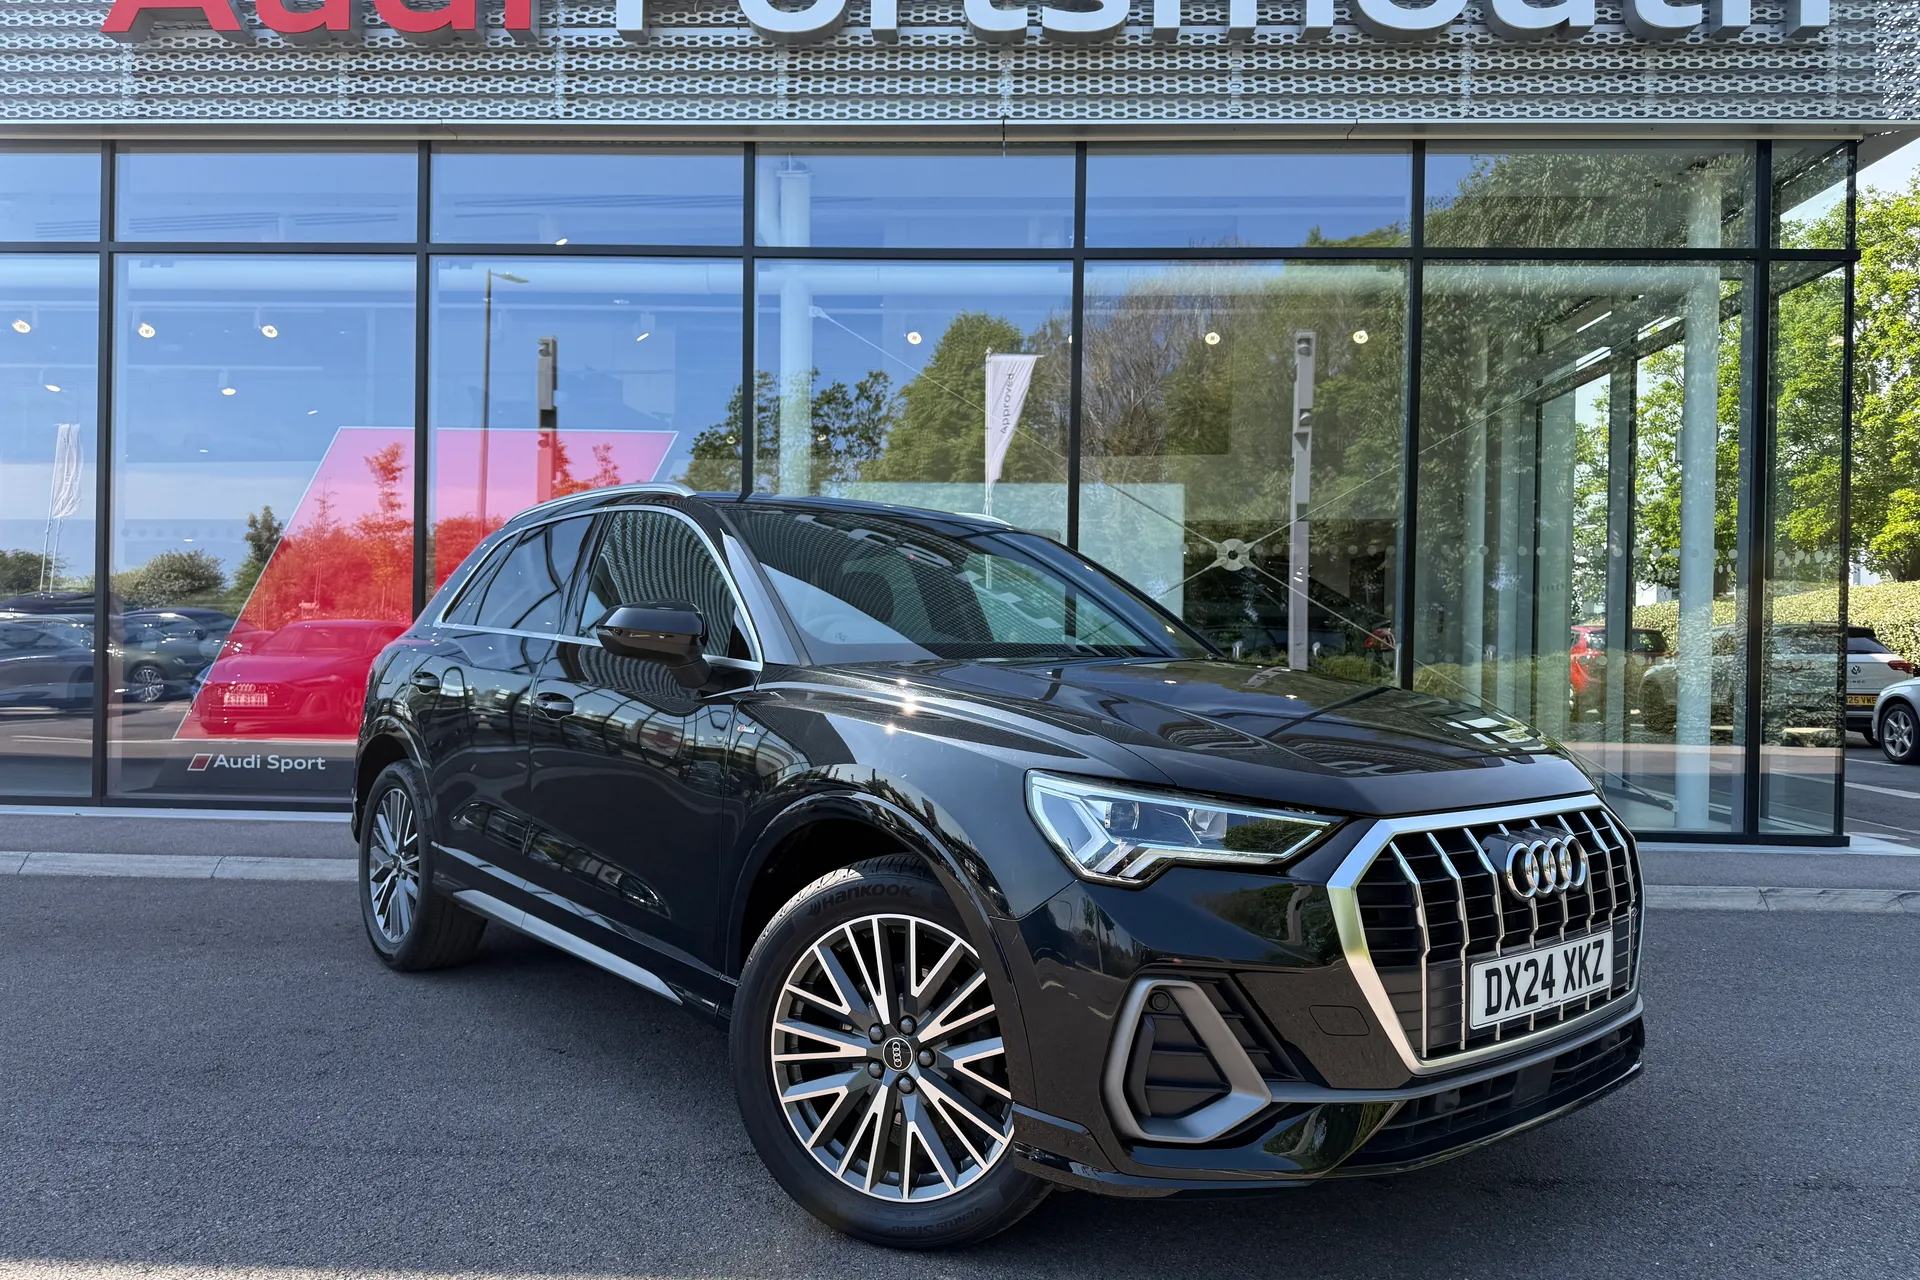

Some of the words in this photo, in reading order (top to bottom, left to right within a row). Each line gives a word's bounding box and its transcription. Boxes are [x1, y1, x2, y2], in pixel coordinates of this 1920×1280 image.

[1000, 373, 1015, 434] Approved
[213, 754, 261, 769] Audi
[267, 754, 326, 773] Sport
[1485, 953, 1556, 1017] DX24
[1563, 938, 1605, 994] XKZ
